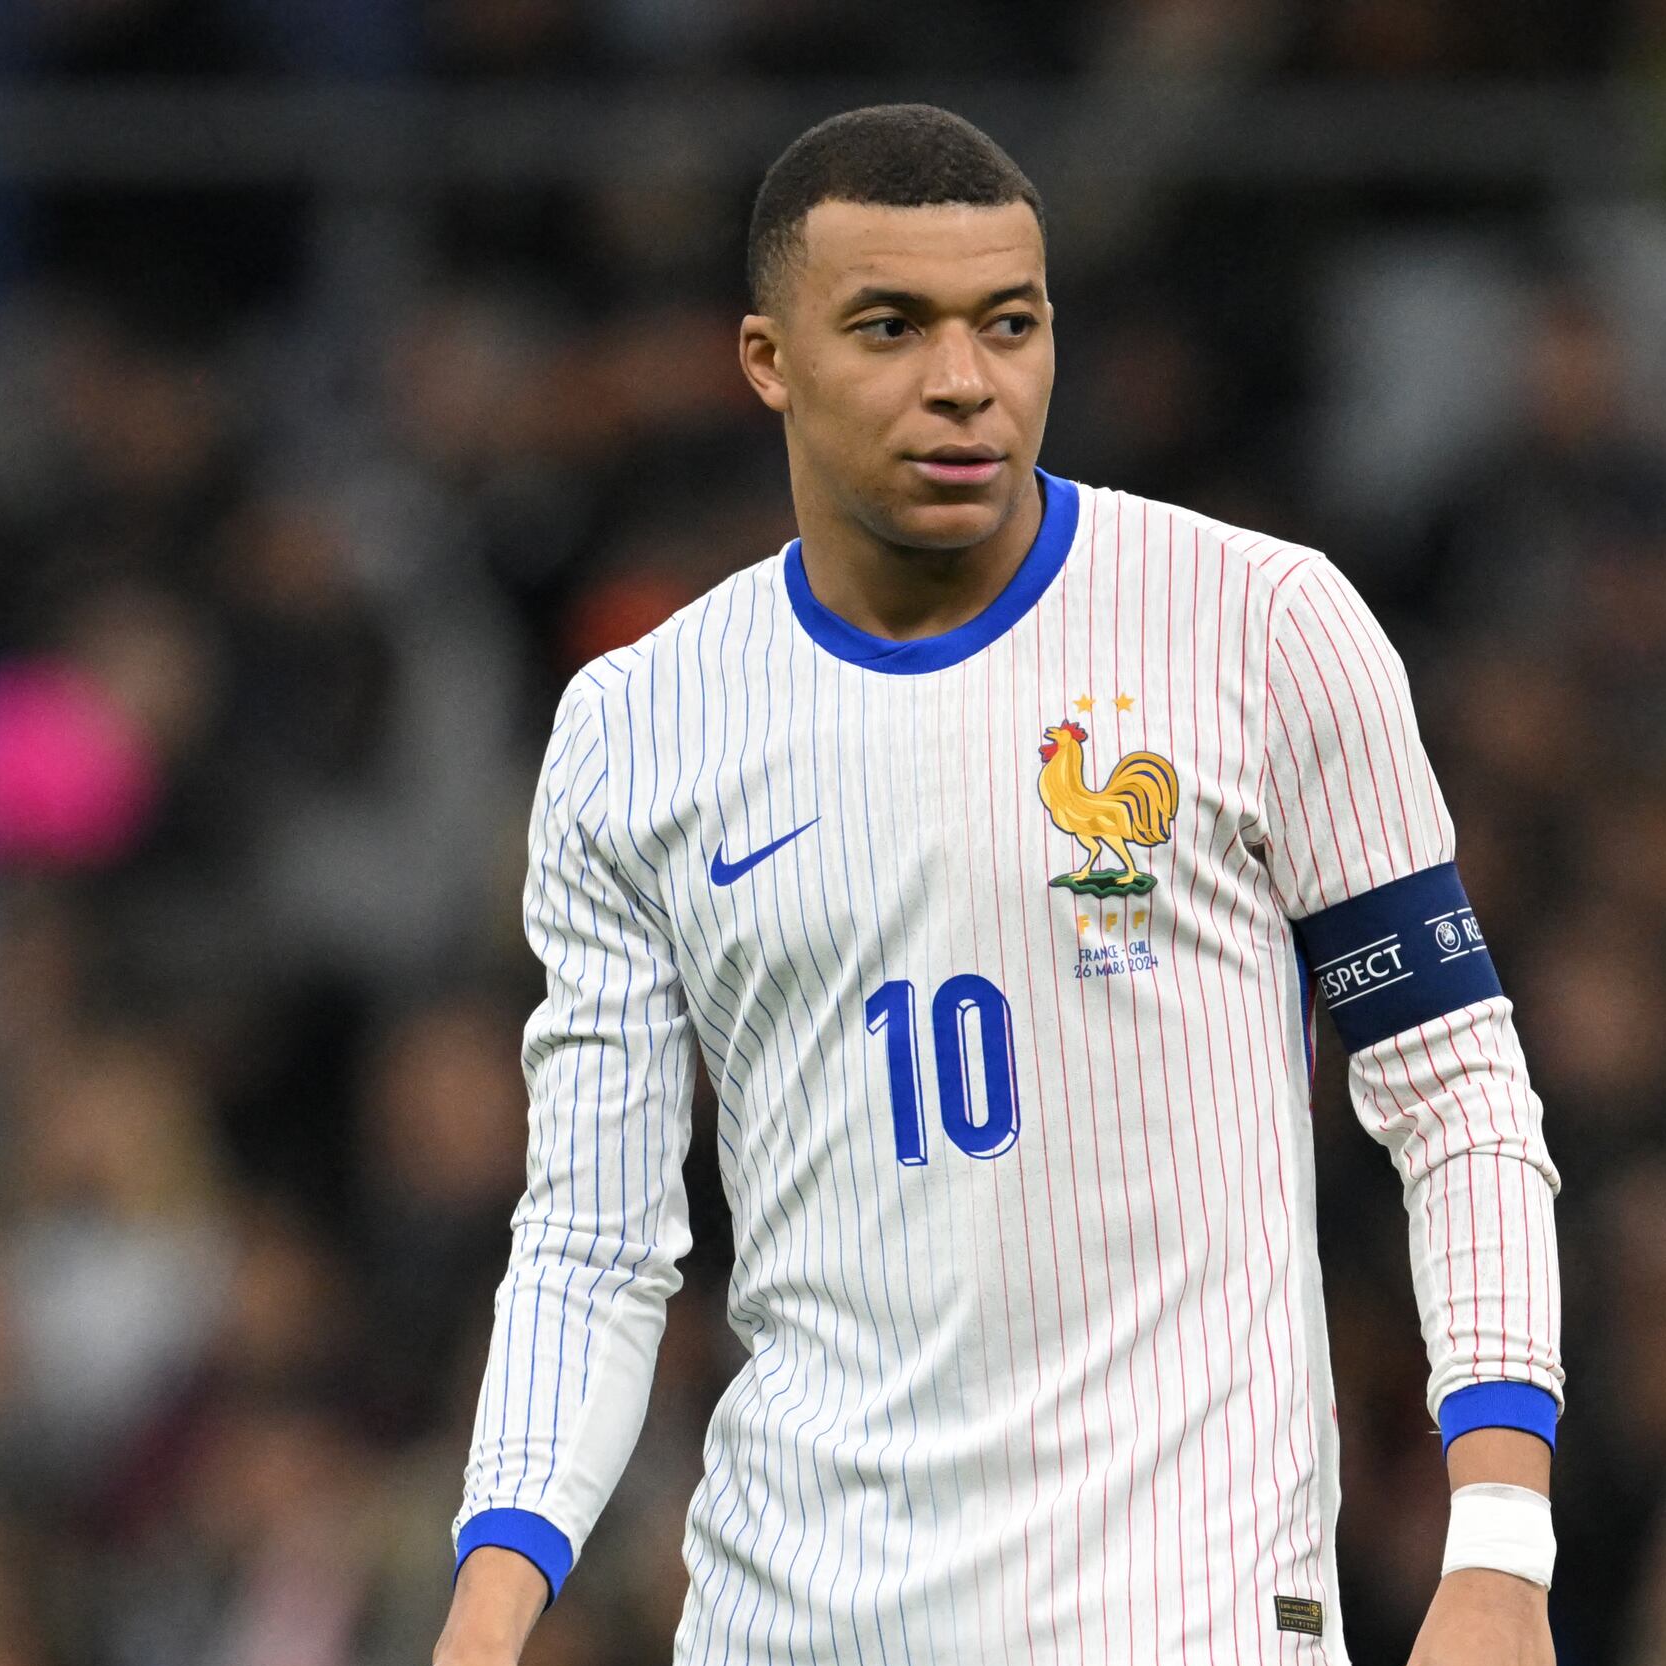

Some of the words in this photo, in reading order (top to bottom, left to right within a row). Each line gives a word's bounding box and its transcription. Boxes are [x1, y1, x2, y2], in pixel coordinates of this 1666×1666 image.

[1073, 964, 1092, 979] 26
[1095, 960, 1126, 977] MARS
[1127, 955, 1159, 972] 2024
[1078, 944, 1119, 963] FRANCE
[1319, 943, 1403, 1000] ESPECT
[865, 973, 1021, 1167] 10
